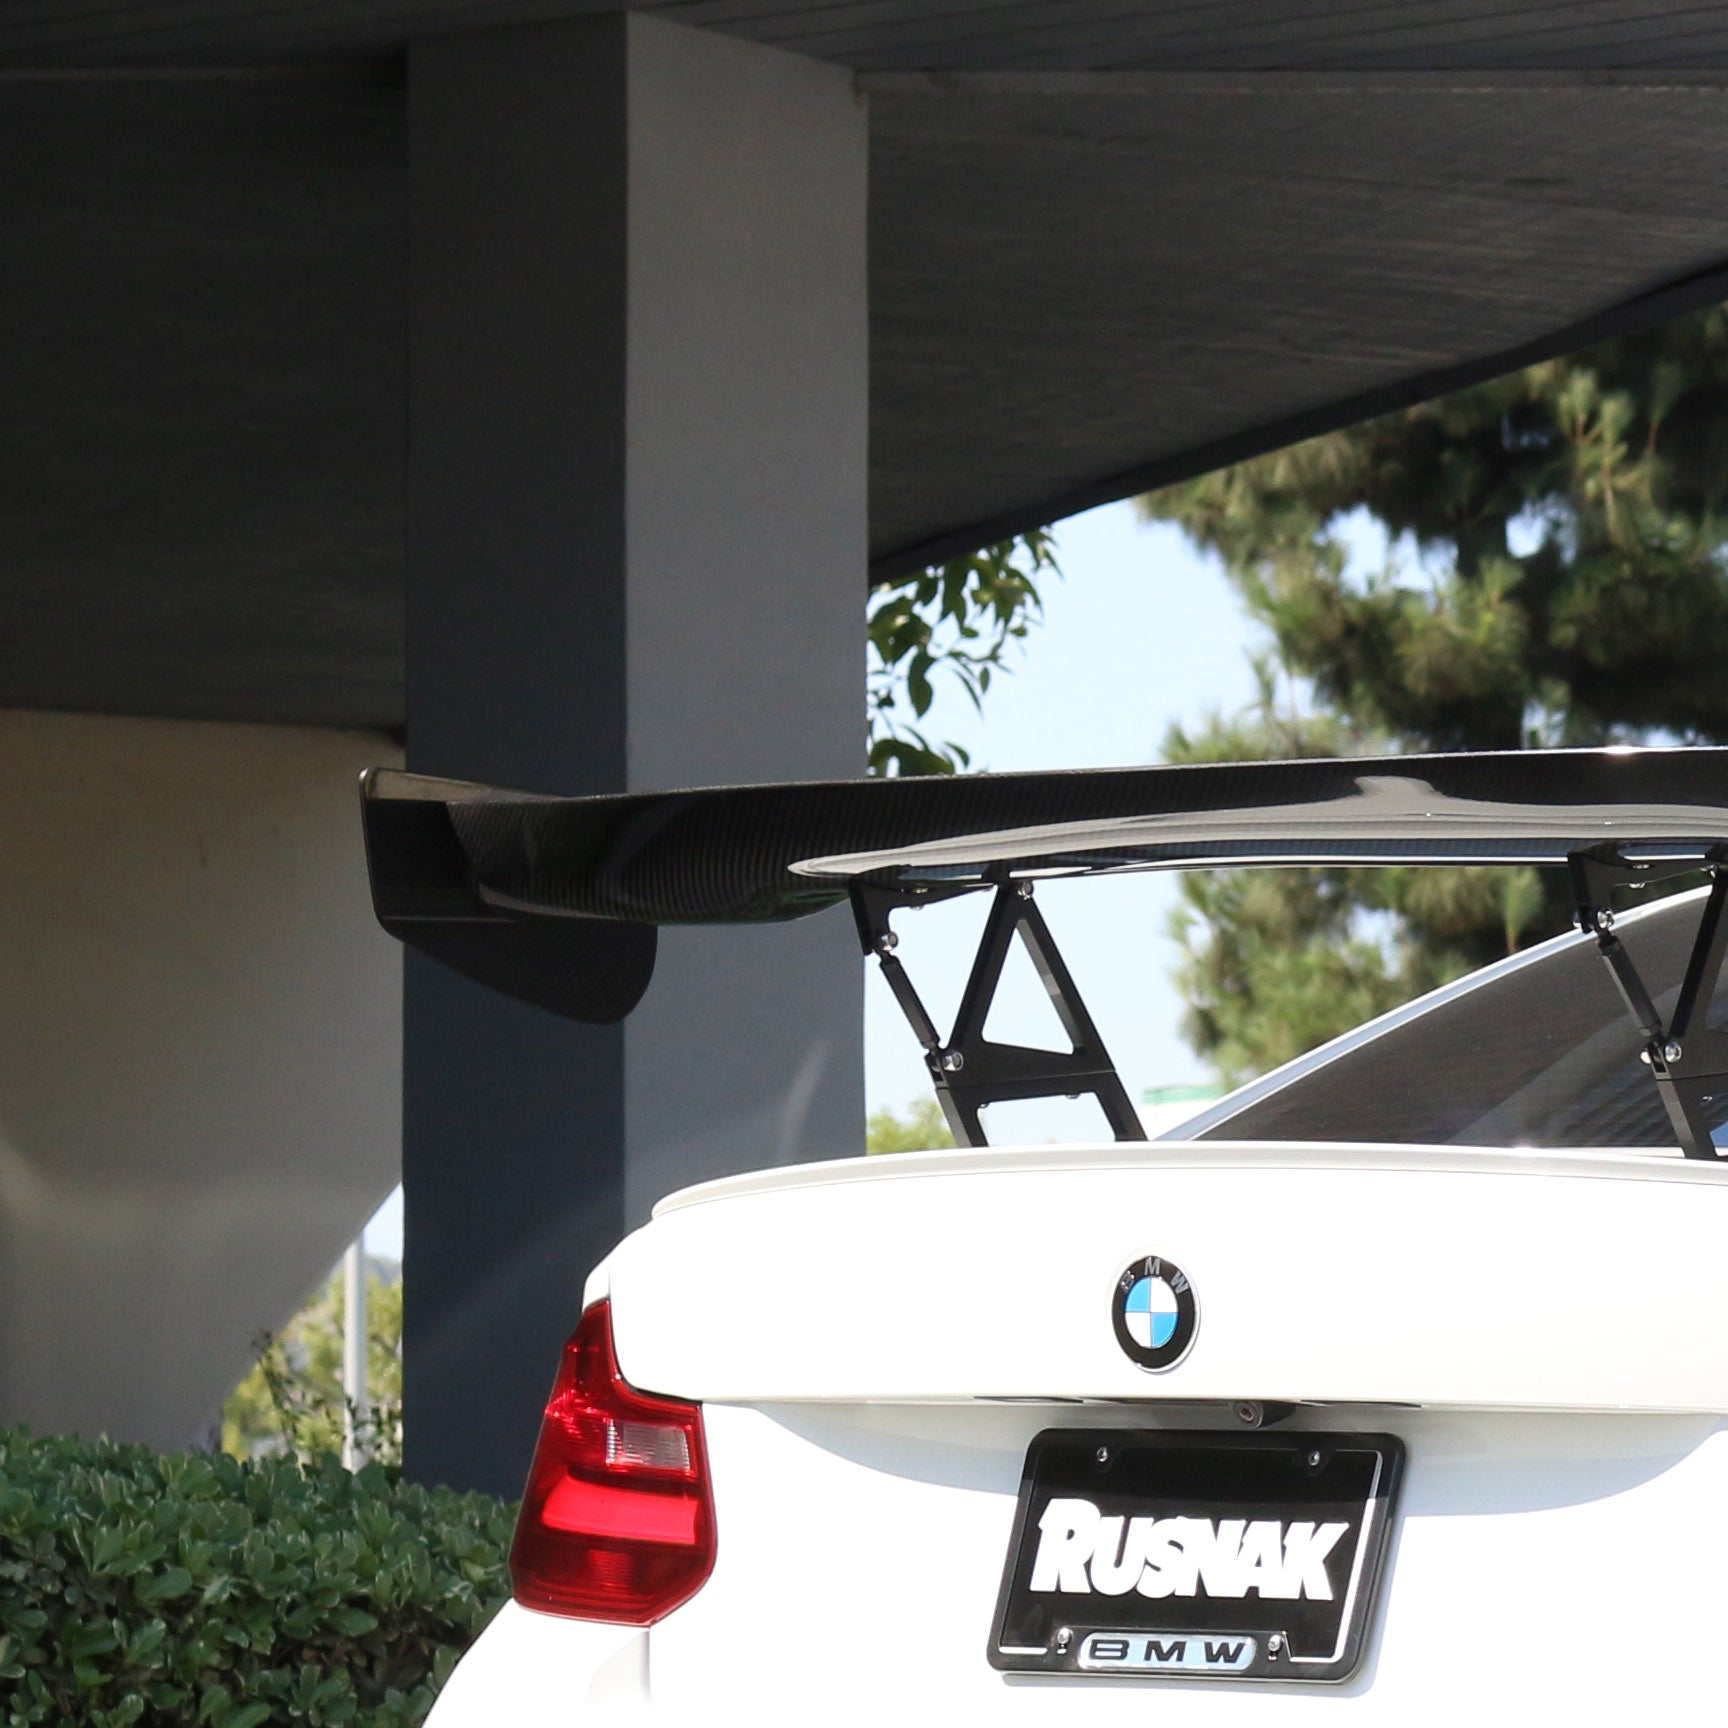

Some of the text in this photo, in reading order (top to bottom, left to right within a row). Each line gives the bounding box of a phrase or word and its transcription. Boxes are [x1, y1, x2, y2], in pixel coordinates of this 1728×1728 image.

[1120, 1256, 1190, 1295] BMW
[1029, 1498, 1350, 1601] RUSNAK
[1088, 1638, 1247, 1665] BMW
